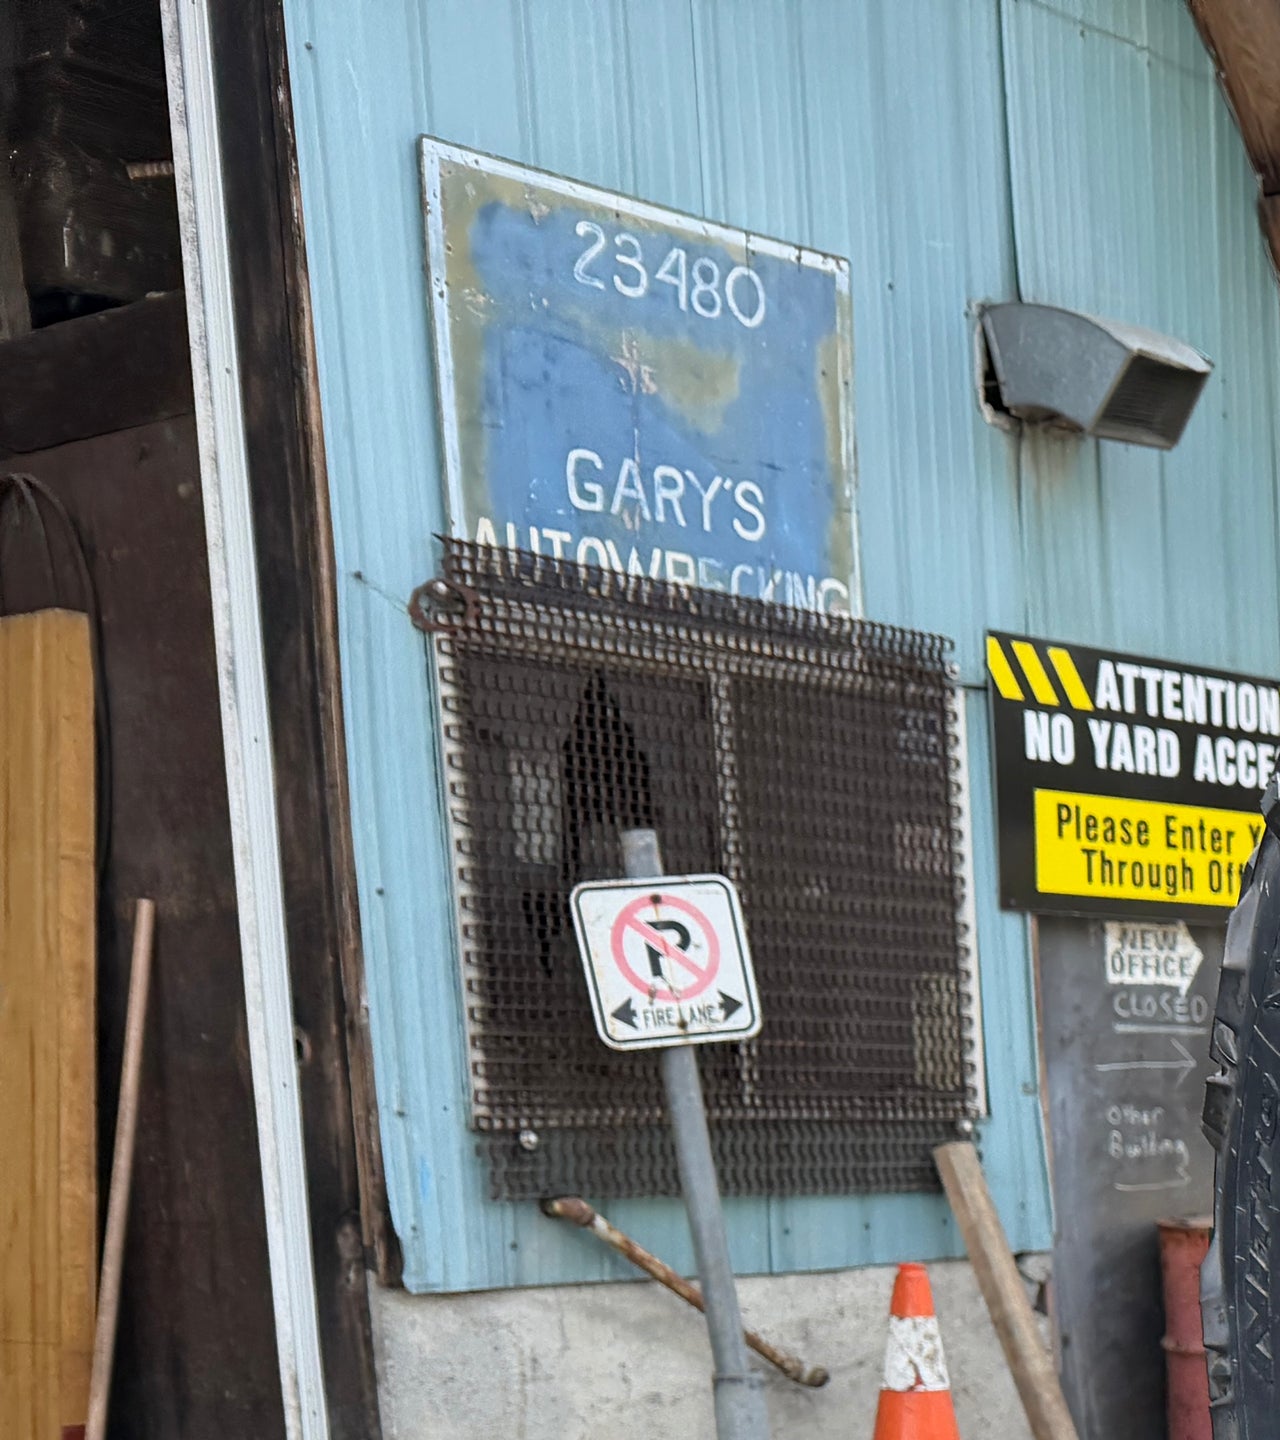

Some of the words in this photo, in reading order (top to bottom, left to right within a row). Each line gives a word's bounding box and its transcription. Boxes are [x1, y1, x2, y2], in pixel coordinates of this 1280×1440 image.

[573, 221, 766, 327] 23480
[566, 448, 767, 542] GARY'S
[1024, 709, 1076, 765] NO
[1088, 718, 1181, 778] YARD
[1194, 734, 1280, 790] ACCE
[1057, 803, 1150, 846] Please
[1165, 815, 1236, 854] Enter
[1081, 848, 1194, 897] Through
[1111, 950, 1195, 978] OFFICE
[1121, 928, 1177, 951] NEW
[643, 1007, 675, 1029] FIRE
[1113, 991, 1209, 1023] CLOSED
